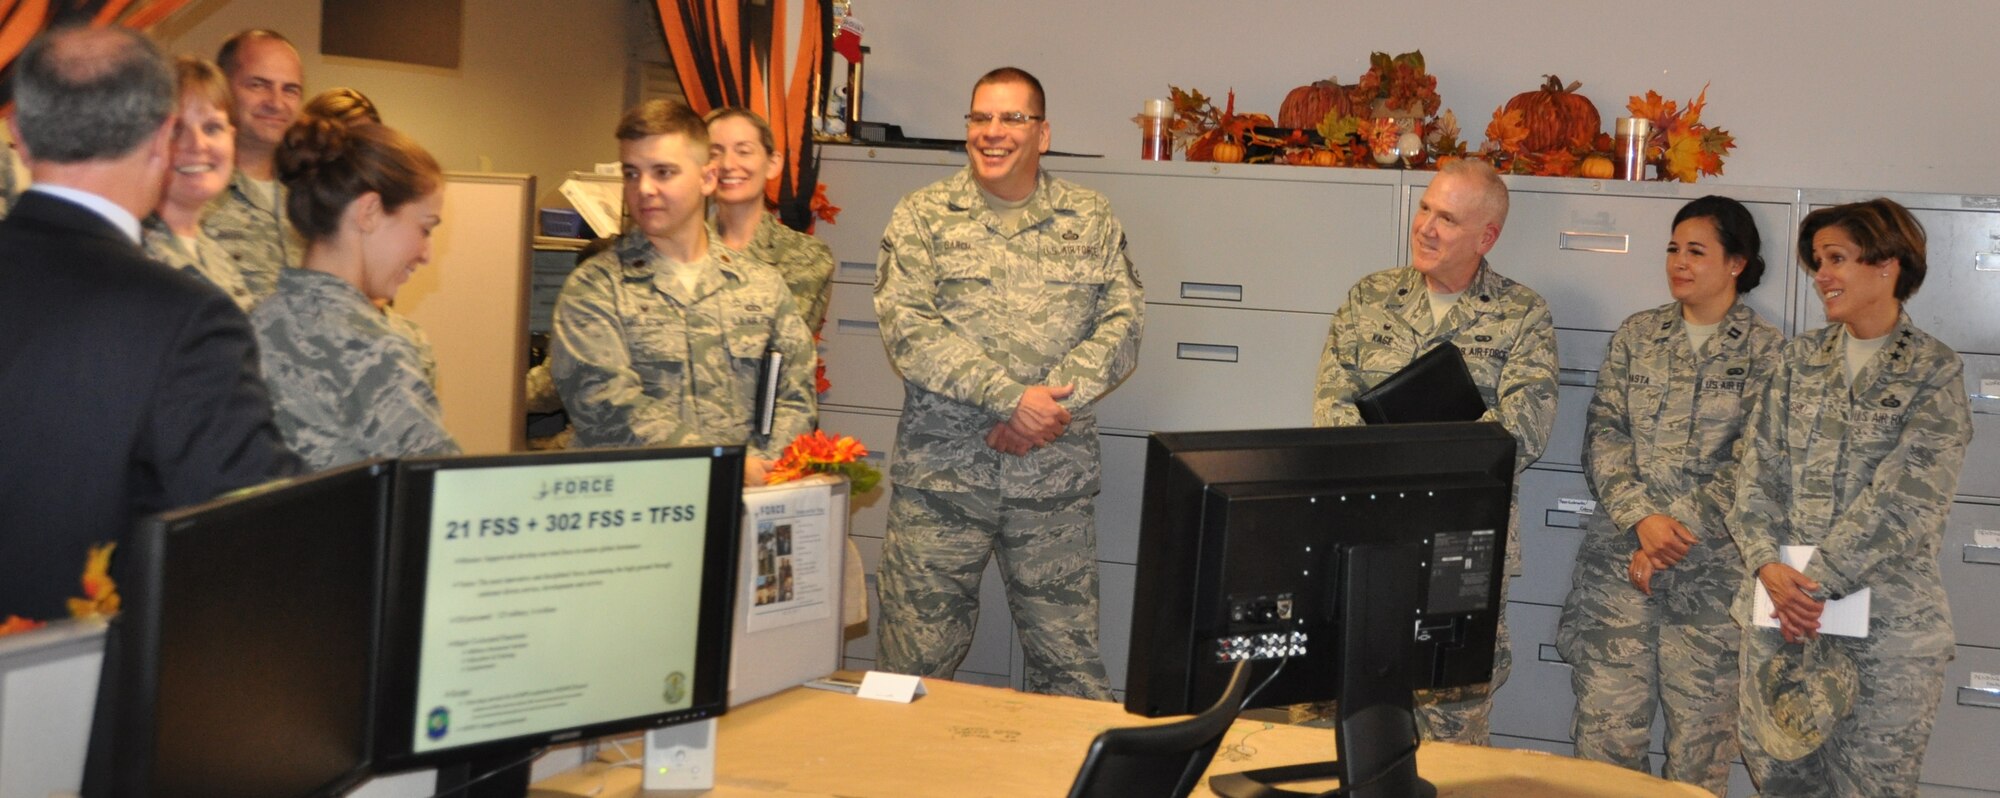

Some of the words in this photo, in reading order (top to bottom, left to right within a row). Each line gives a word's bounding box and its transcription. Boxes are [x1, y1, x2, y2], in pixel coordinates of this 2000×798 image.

[1469, 347, 1483, 357] AIR
[1484, 347, 1509, 360] FORCE
[553, 478, 614, 495] FORCE
[445, 520, 470, 540] 21
[479, 516, 520, 538] FSS
[526, 519, 539, 532] +
[545, 512, 582, 533] 302
[588, 508, 625, 529] FSS
[649, 503, 696, 525] TFSS
